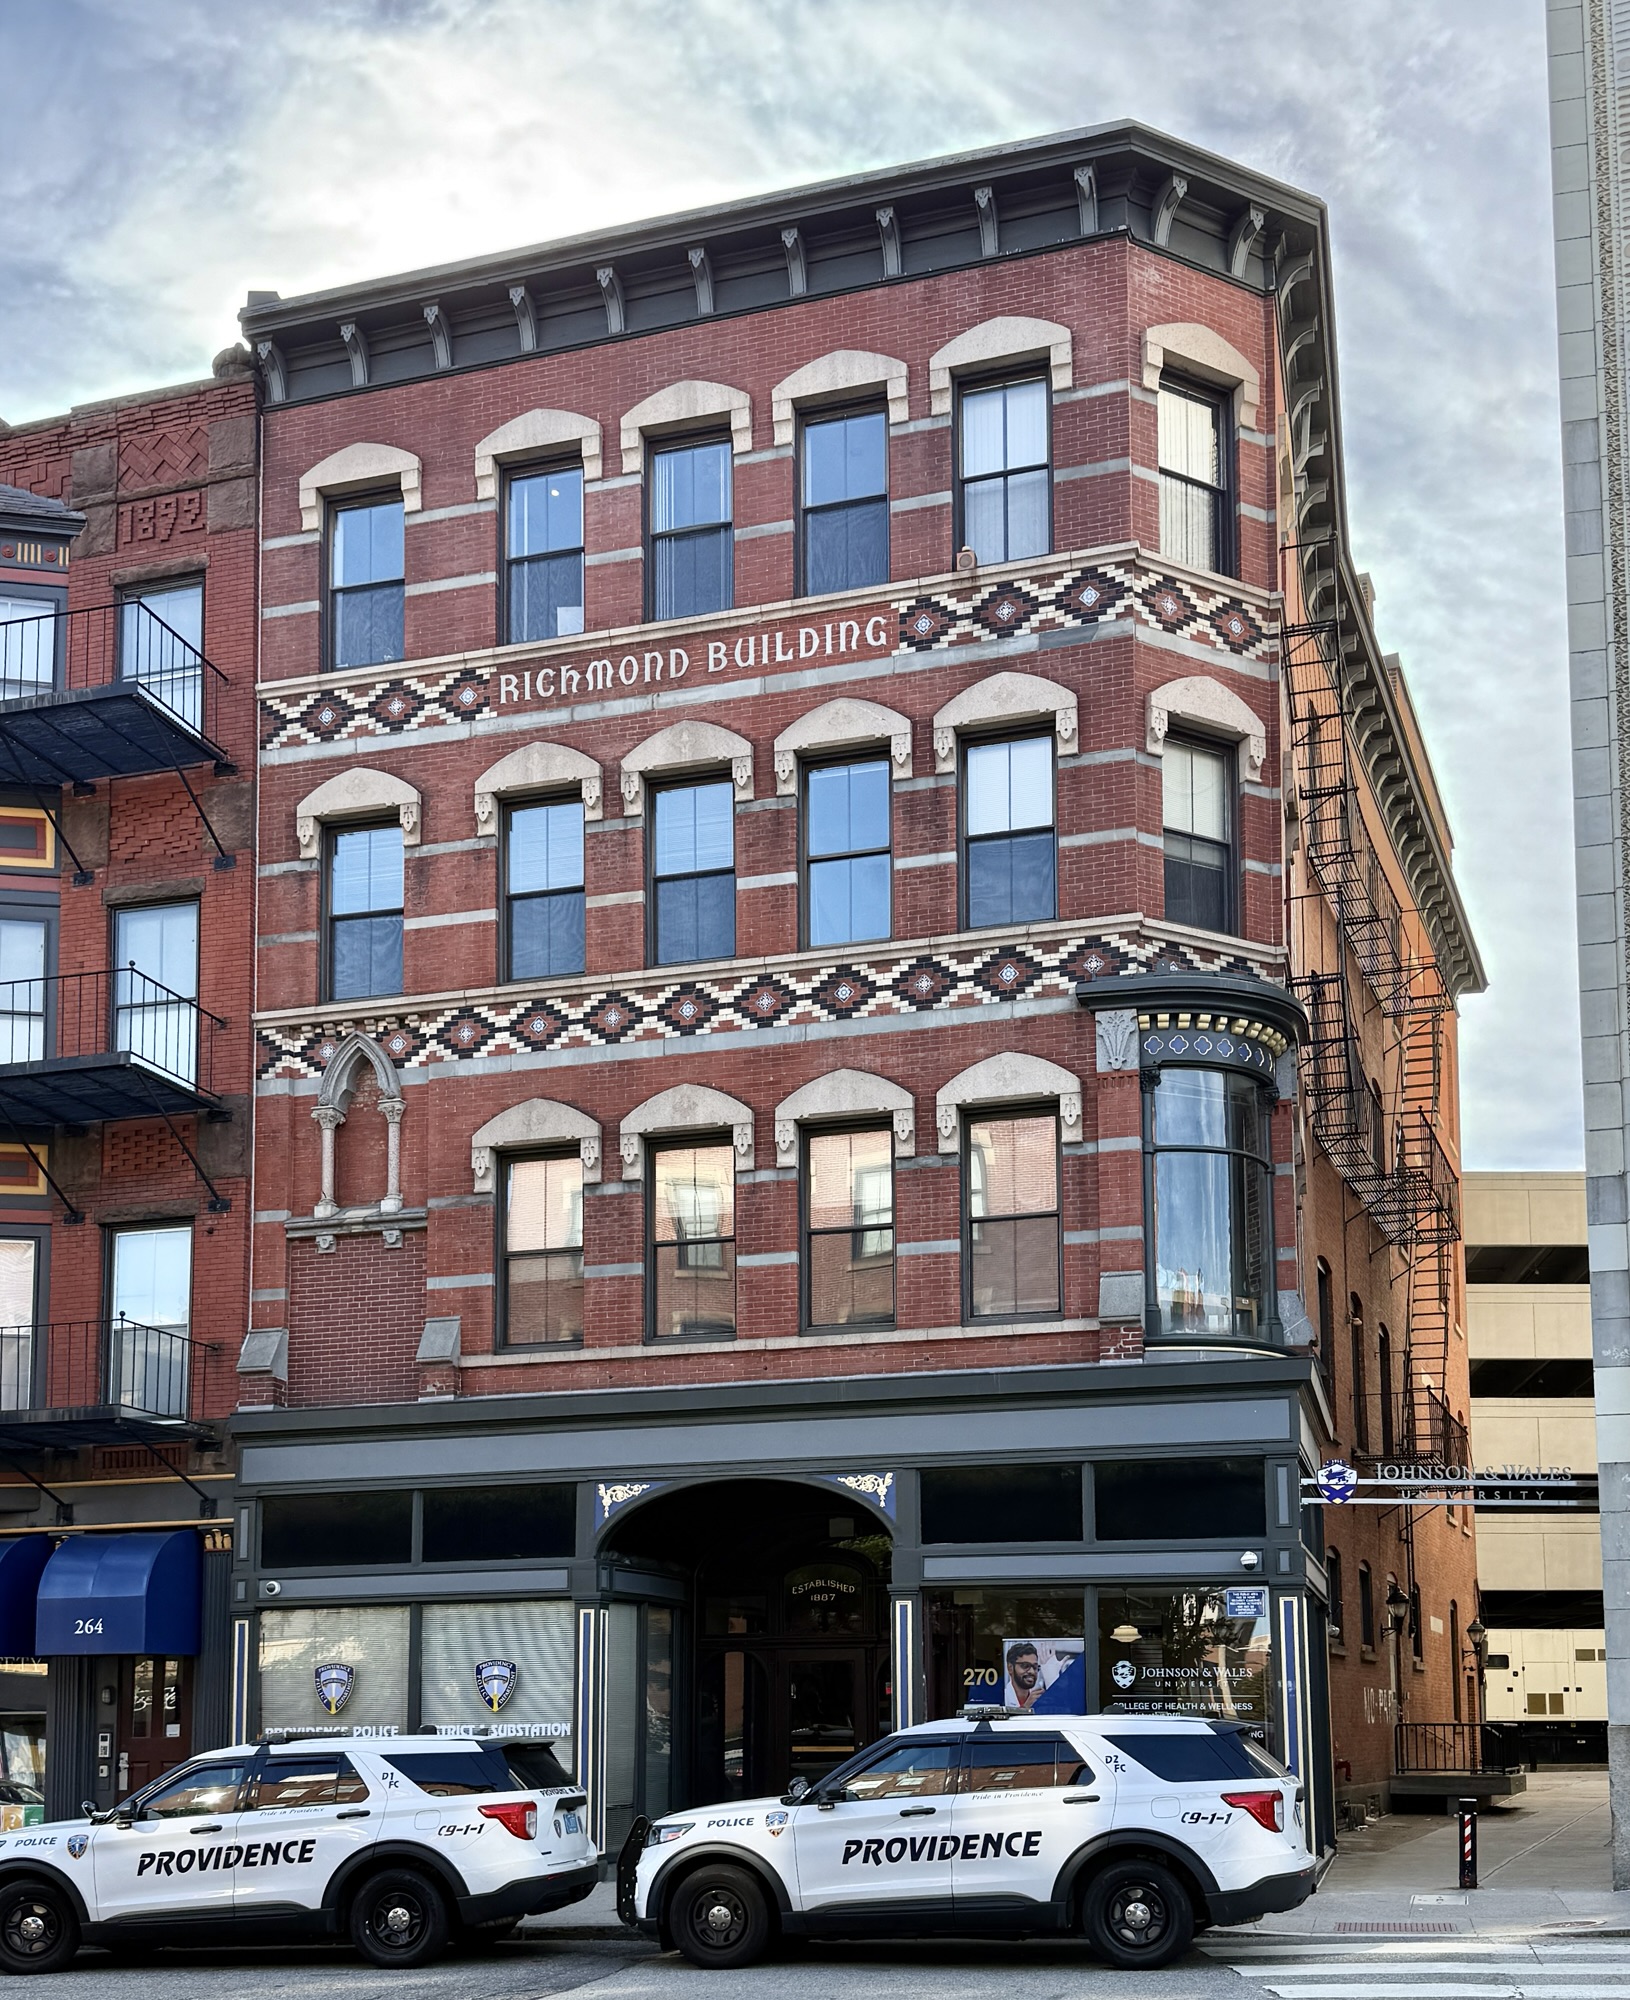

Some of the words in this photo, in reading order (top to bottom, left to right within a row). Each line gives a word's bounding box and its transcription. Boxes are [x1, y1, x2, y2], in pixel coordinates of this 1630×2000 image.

[118, 492, 205, 544] 1892
[499, 648, 690, 704] RICHMOND
[708, 616, 887, 673] BUILDING
[1374, 1462, 1478, 1482] JOHNSON
[1484, 1464, 1500, 1481] &
[1501, 1463, 1572, 1481] WALES
[1400, 1489, 1546, 1500] UNIVERSITY
[792, 1579, 855, 1595] ESTABLISHED
[810, 1593, 836, 1601] 1887
[74, 1618, 104, 1634] 264
[963, 1667, 998, 1686] 270
[1141, 1666, 1199, 1679] JOHNSON
[1202, 1667, 1213, 1678] &
[1213, 1666, 1253, 1678] WALES
[1154, 1680, 1238, 1688] UNIVERSITY
[1151, 1702, 1163, 1710] OF
[1165, 1702, 1198, 1710] HEALTH
[1200, 1702, 1206, 1710] &
[1207, 1702, 1253, 1711] WELLNESS
[353, 1725, 399, 1738] POLICE
[490, 1722, 571, 1738] SUBSTATION
[1105, 1754, 1119, 1764] D2
[1114, 1763, 1126, 1773] FC
[381, 1771, 394, 1781] D1
[388, 1780, 400, 1789] FC
[707, 1817, 755, 1828] POLICE
[14, 1836, 58, 1848] POLICE
[841, 1830, 1042, 1867] PROVIDENCE
[136, 1838, 317, 1877] PROVIDENCE
